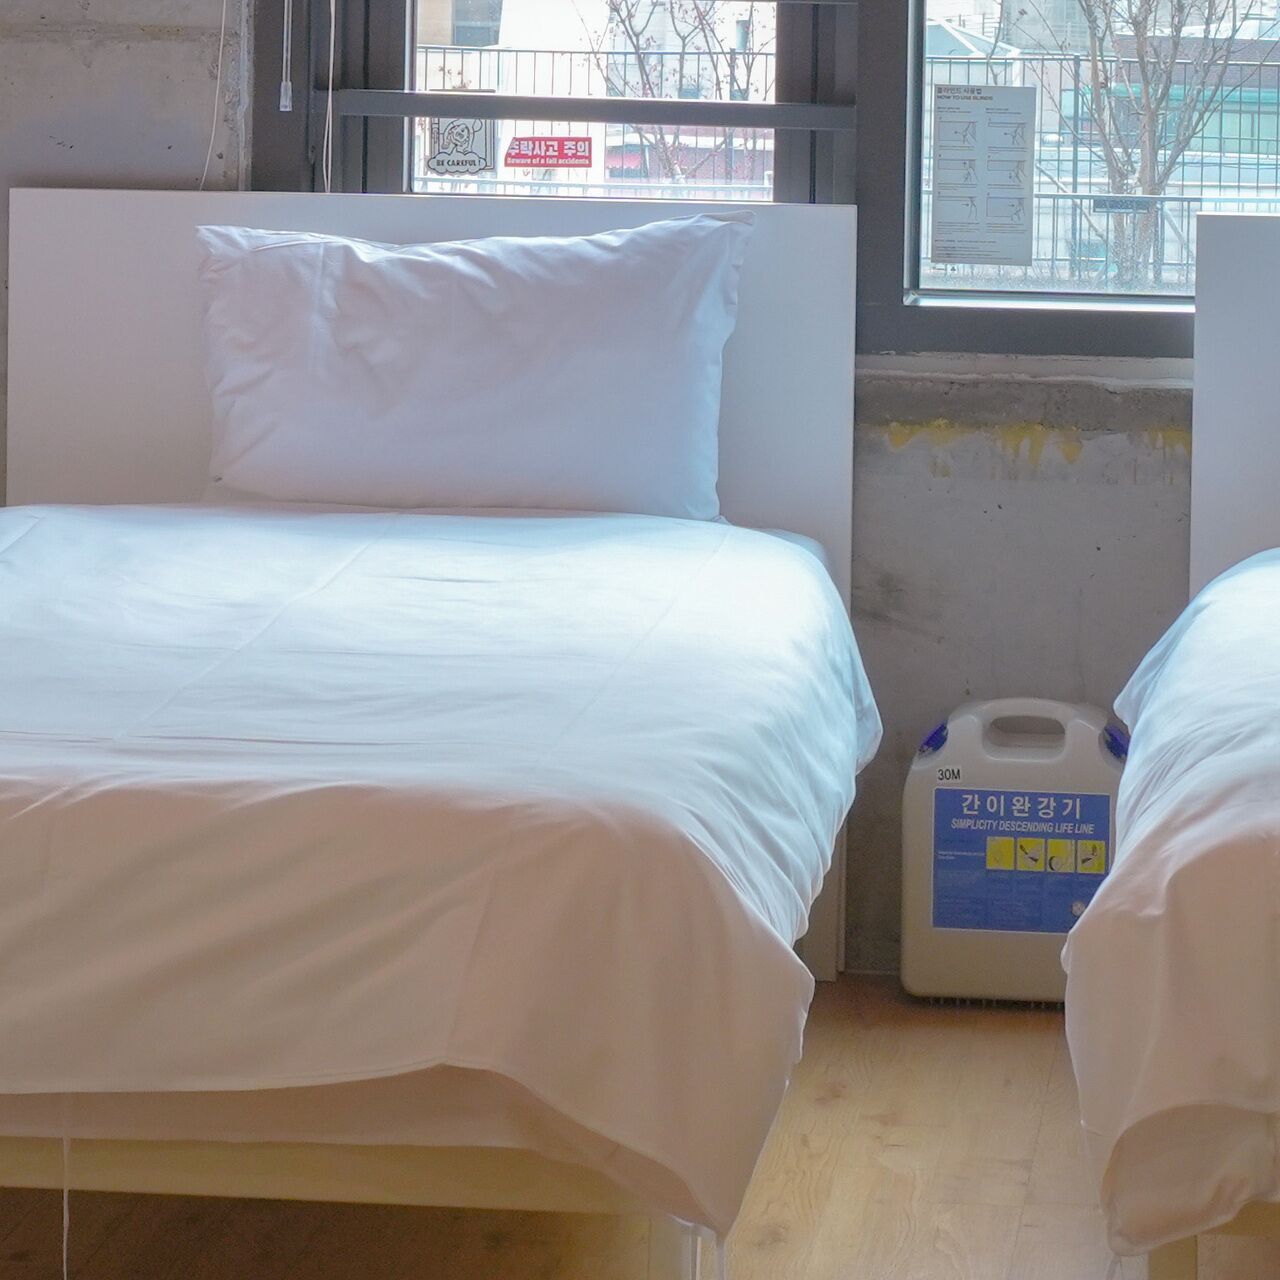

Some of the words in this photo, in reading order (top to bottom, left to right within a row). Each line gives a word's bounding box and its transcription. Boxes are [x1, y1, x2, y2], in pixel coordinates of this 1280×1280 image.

[563, 141, 589, 156] 주의
[937, 768, 961, 781] 30M
[950, 817, 998, 830] SIMPLICITY
[998, 819, 1054, 833] DESCENDING
[1055, 822, 1074, 834] LIFE
[1075, 823, 1095, 835] LINE
